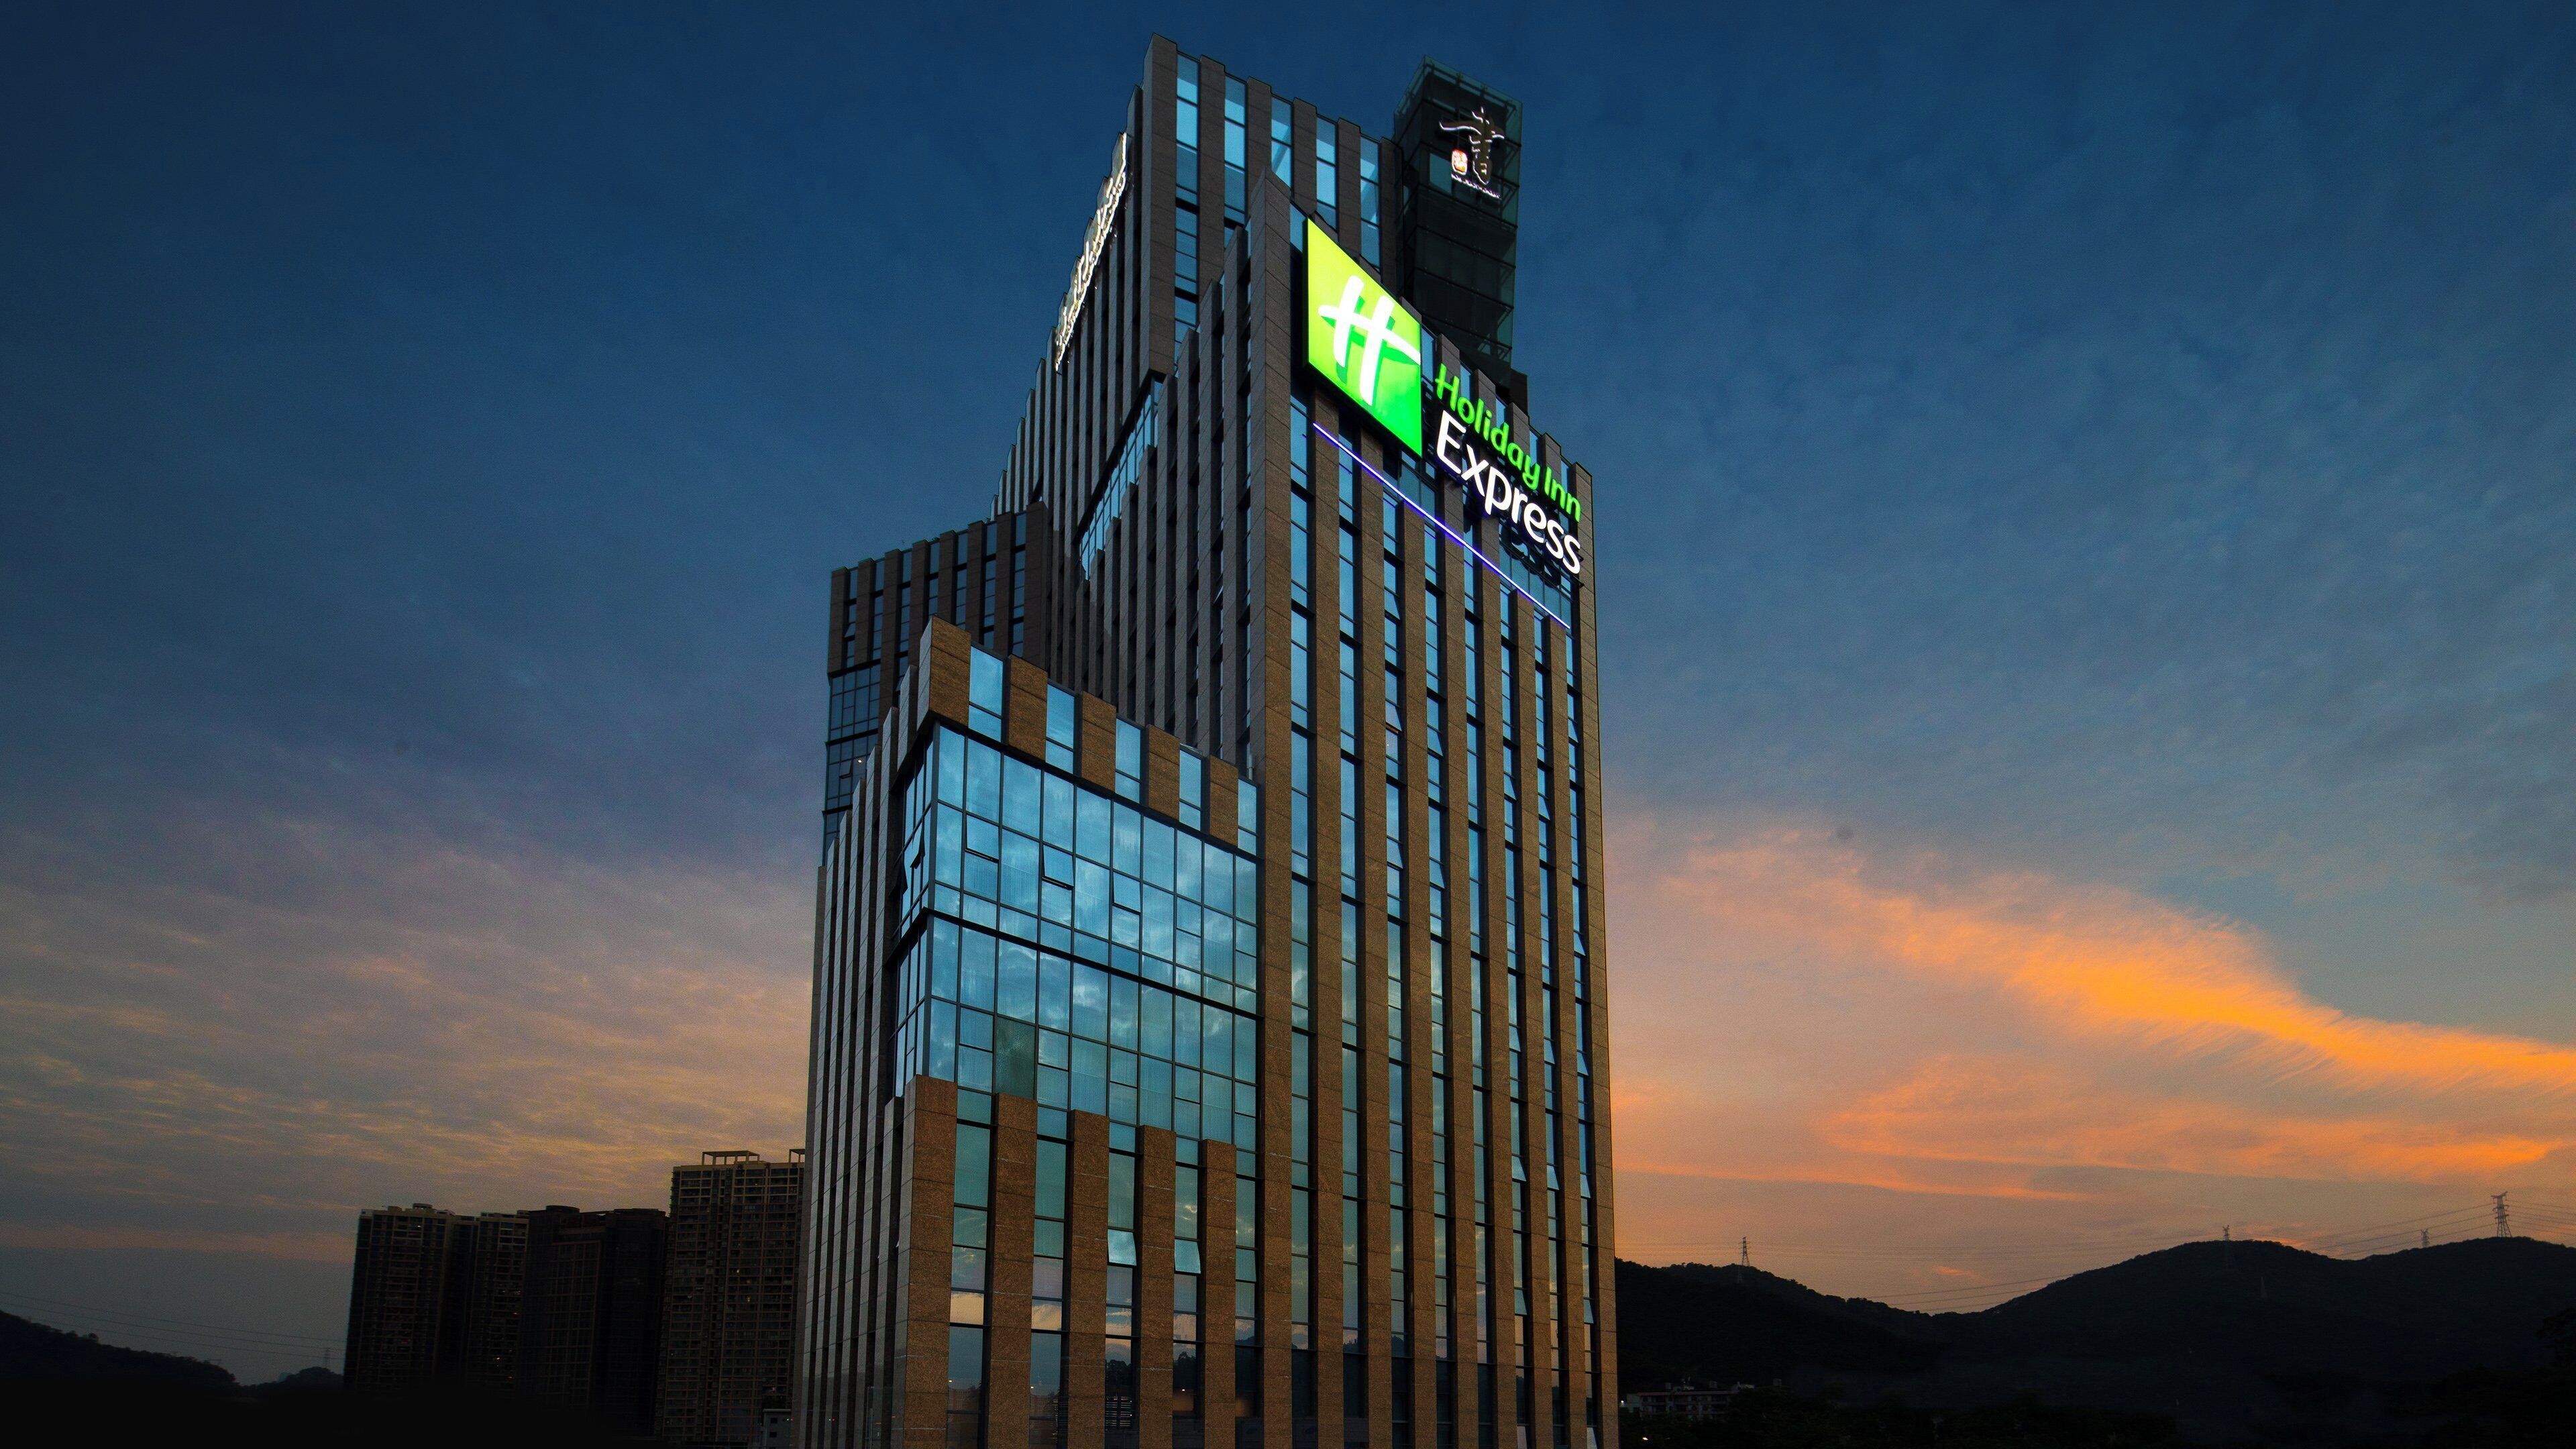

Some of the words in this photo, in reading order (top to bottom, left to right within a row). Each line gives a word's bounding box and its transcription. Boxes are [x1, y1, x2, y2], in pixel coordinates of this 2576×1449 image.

[1319, 275, 1420, 406] H
[1435, 364, 1541, 490] Holiday
[1544, 472, 1581, 522] Inn
[1436, 411, 1580, 574] Express
